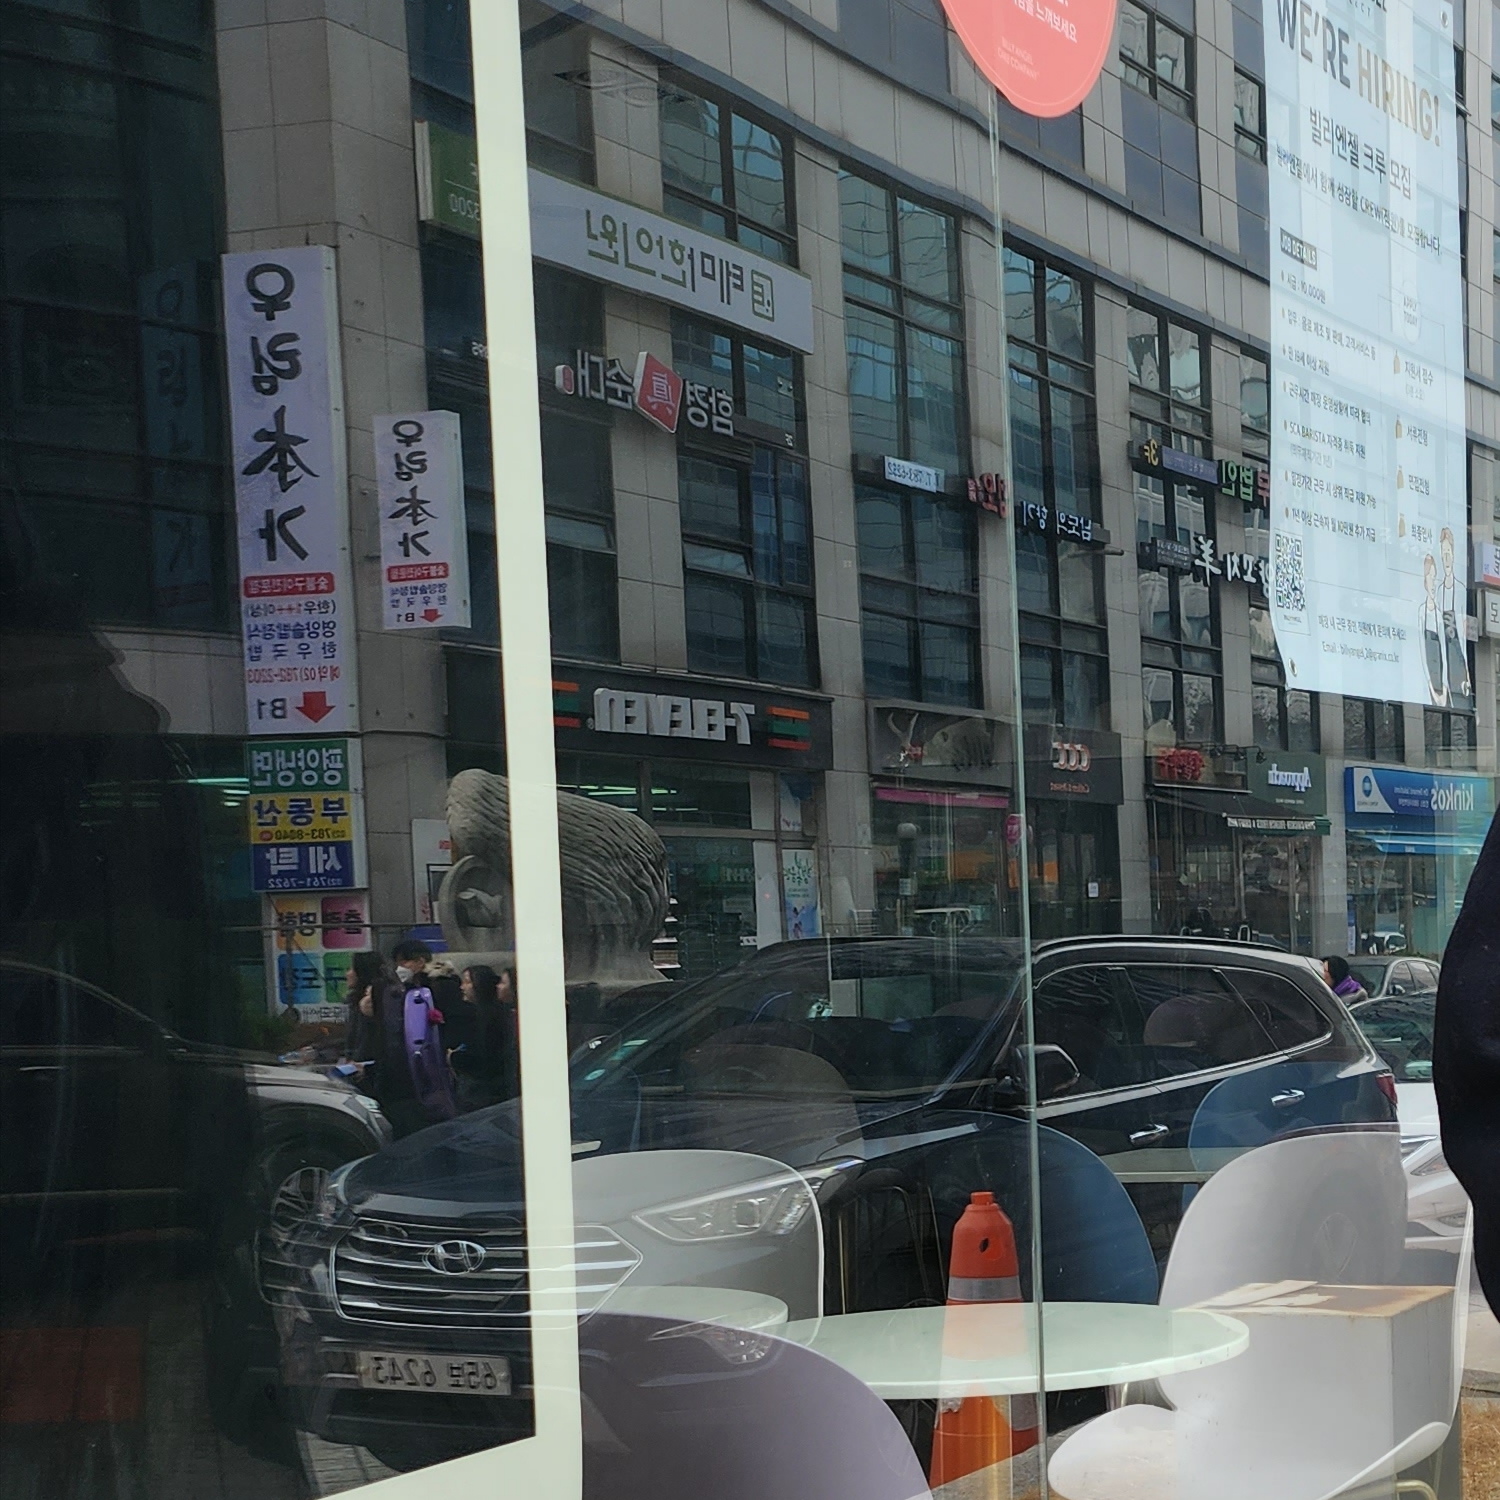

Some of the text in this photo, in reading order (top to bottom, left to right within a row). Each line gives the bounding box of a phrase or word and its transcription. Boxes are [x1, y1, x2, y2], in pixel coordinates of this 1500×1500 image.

[1035, 1, 1077, 43] 느껴보세요
[1277, 0, 1440, 147] WE'RE HIRING!
[1309, 106, 1411, 201] 빌리엔젤 크루 모집
[1337, 183, 1359, 212] 성장할
[1292, 238, 1317, 266] DETAILS
[1289, 421, 1300, 438] SCA
